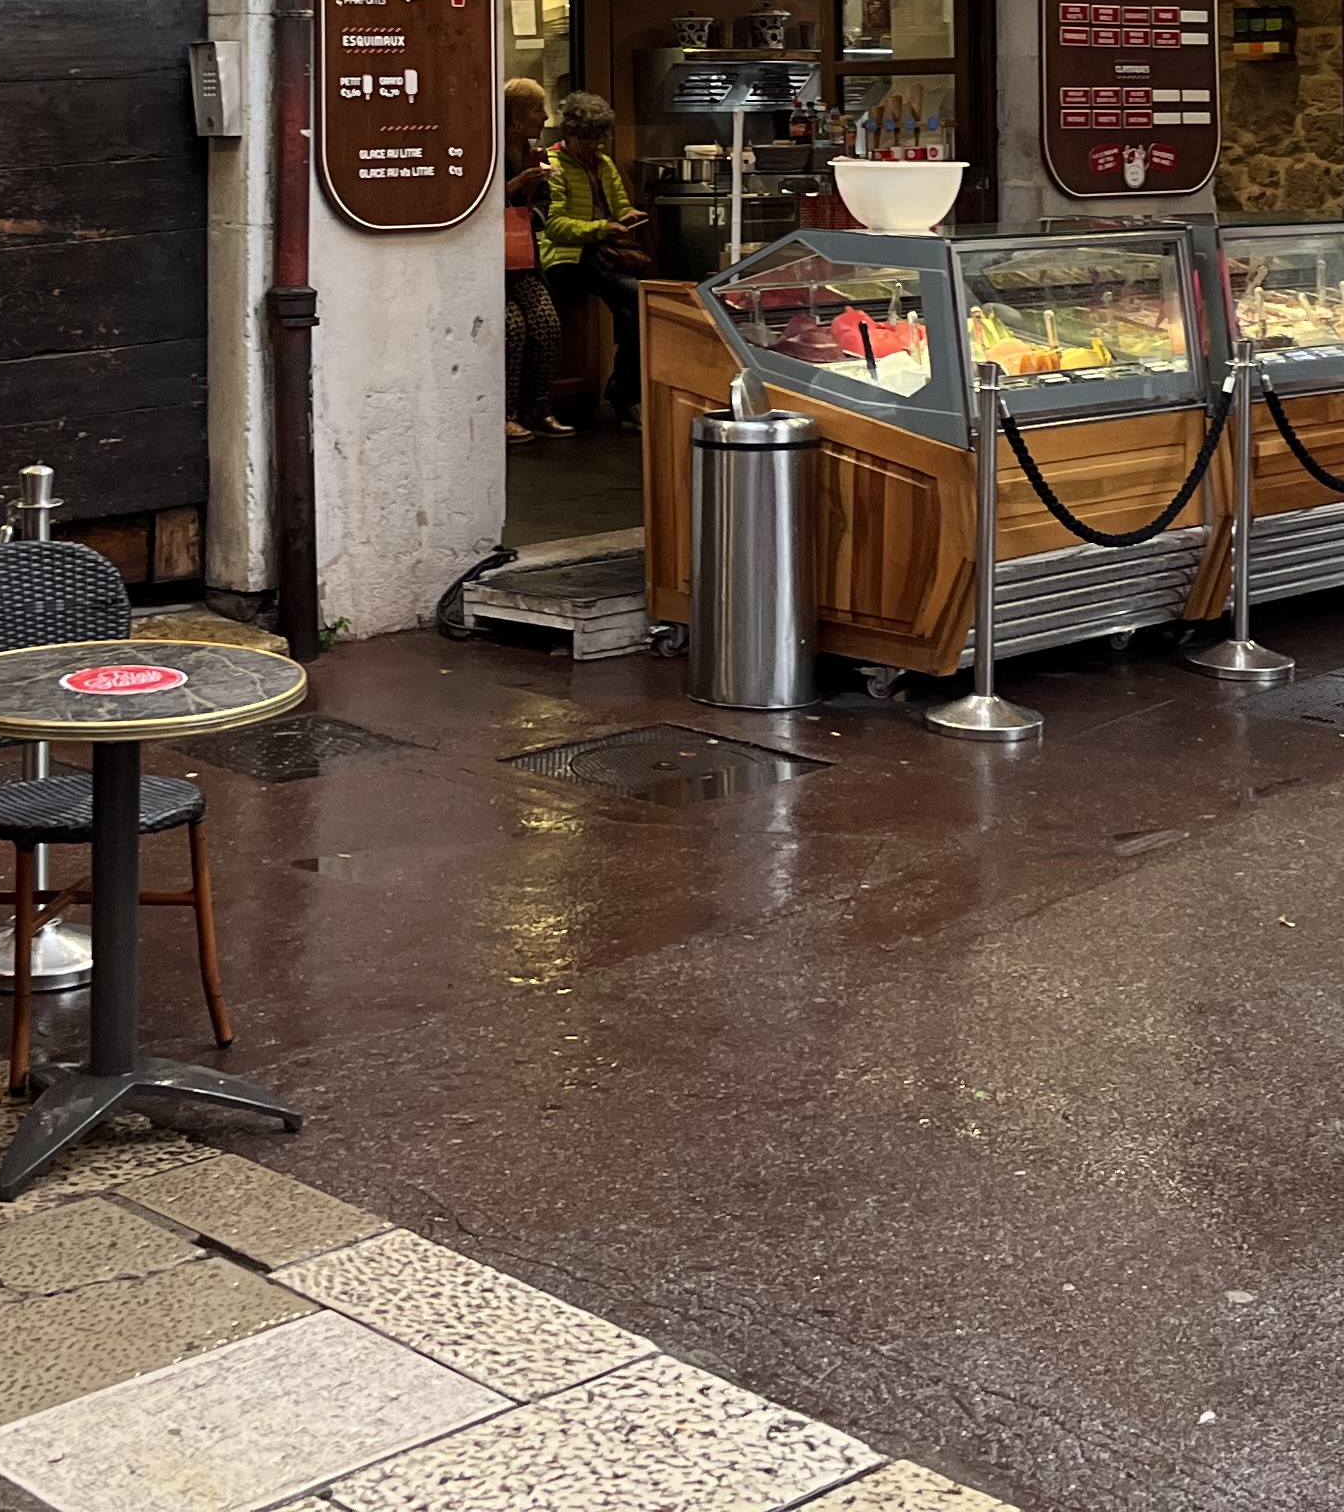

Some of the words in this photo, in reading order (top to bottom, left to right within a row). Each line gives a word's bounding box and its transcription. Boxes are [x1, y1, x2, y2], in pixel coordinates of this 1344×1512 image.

[342, 35, 405, 47] ESQUIMAUX
[358, 149, 386, 160] GLACE
[358, 168, 386, 179] GLACE
